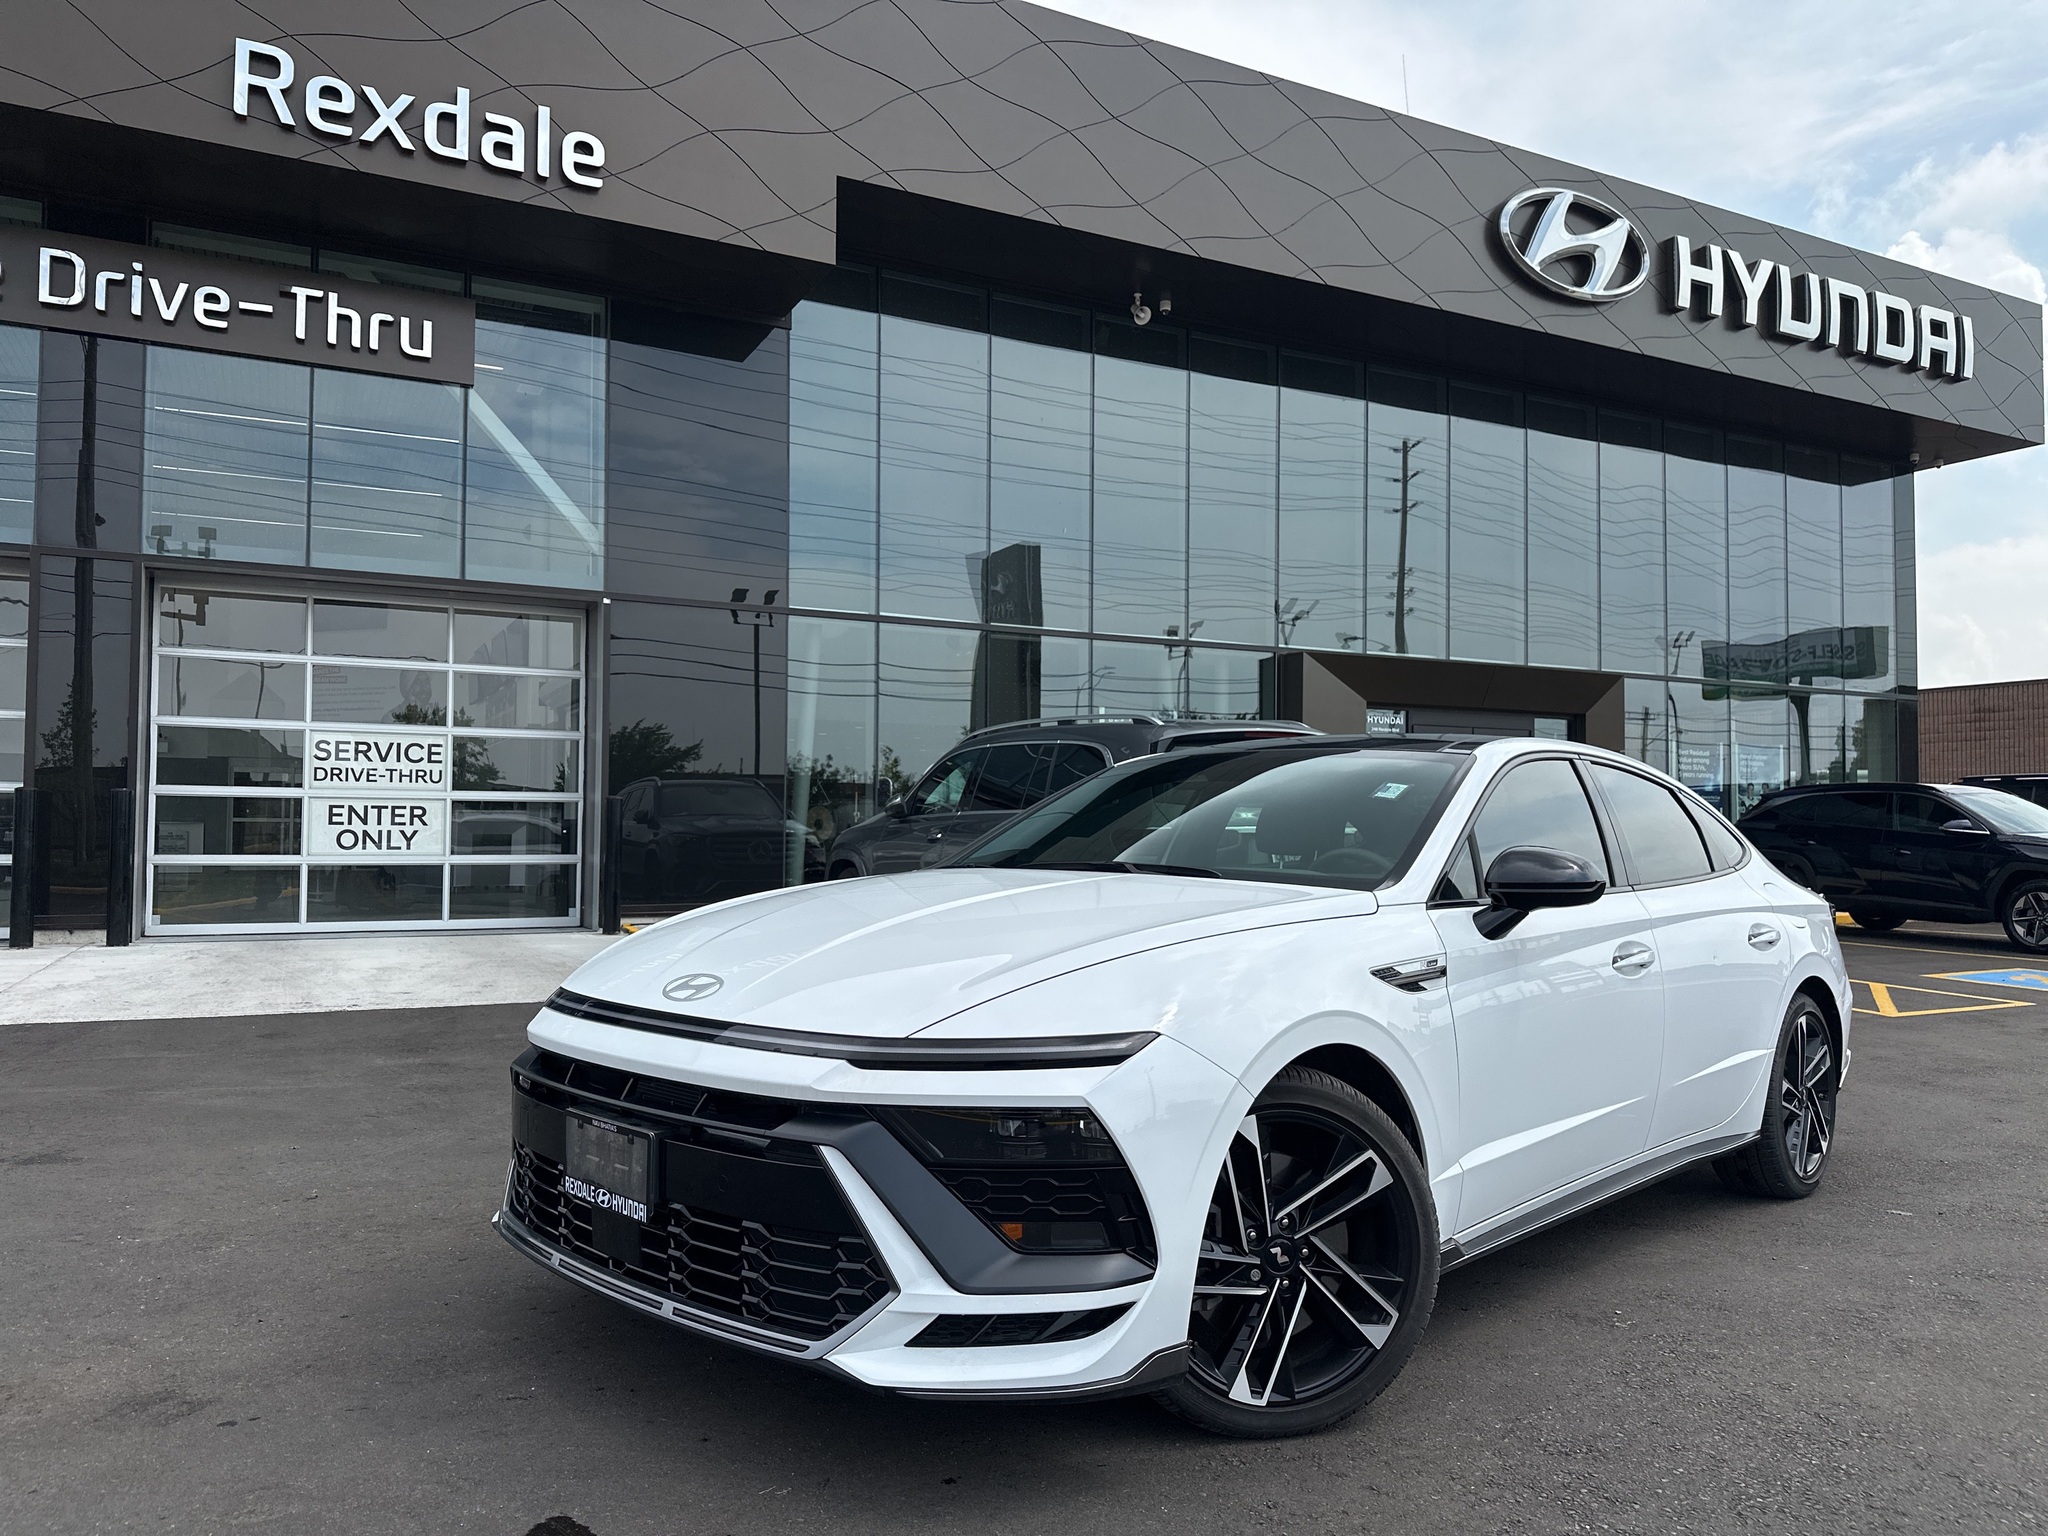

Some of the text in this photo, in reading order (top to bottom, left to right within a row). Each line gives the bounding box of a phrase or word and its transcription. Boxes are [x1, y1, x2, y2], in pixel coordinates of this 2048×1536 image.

[232, 37, 606, 189] Rexdale
[38, 246, 434, 360] Drive-Thru
[1672, 235, 1975, 380] HYUNDAI
[1367, 715, 1403, 724] HYUNDAI
[313, 739, 443, 764] SERVICE
[313, 766, 443, 784] DRIVE-THRU
[327, 804, 429, 827] ENTER
[335, 828, 419, 851] ONLY
[565, 1175, 648, 1224] REXDALE HYUNDAI
